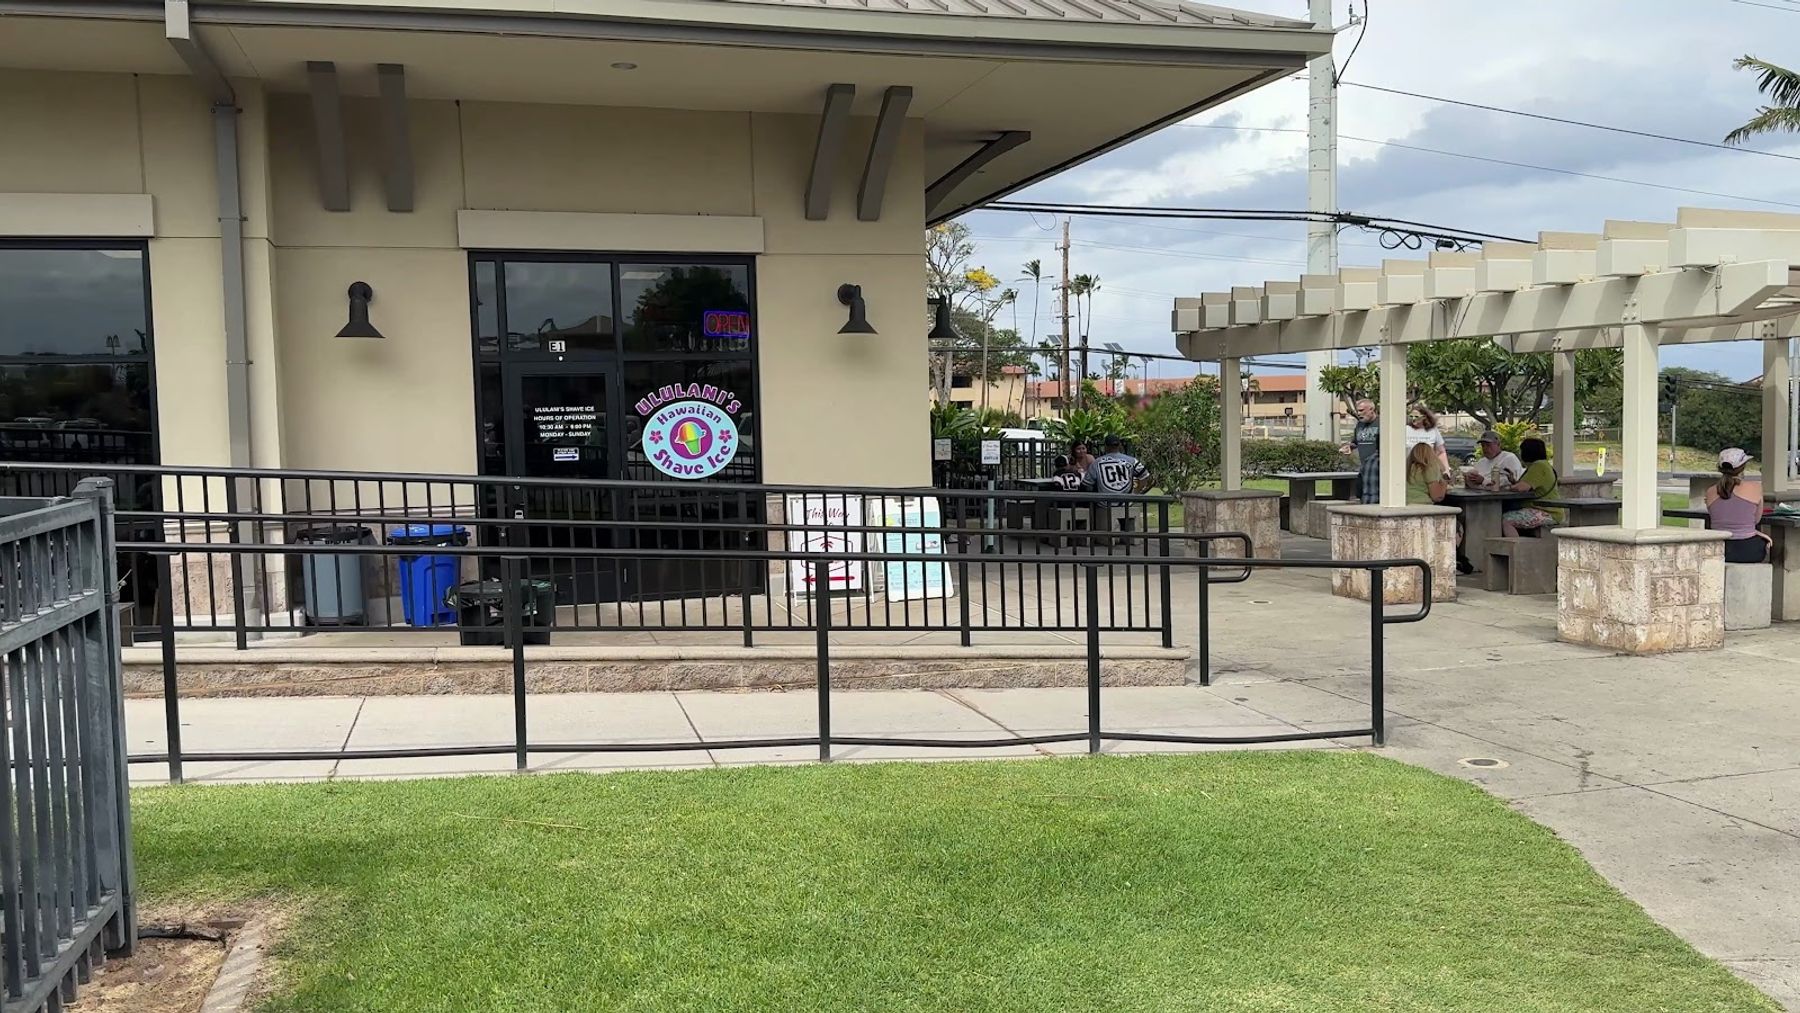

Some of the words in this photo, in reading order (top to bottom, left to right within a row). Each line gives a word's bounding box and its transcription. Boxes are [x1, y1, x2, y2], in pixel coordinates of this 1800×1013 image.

[706, 313, 748, 334] OPEN
[550, 342, 564, 352] E1
[634, 382, 742, 416] ULULANI'S
[656, 405, 722, 425] Hawaiian
[653, 449, 704, 475] Shave
[707, 445, 731, 469] Ice
[1061, 473, 1079, 490] 12
